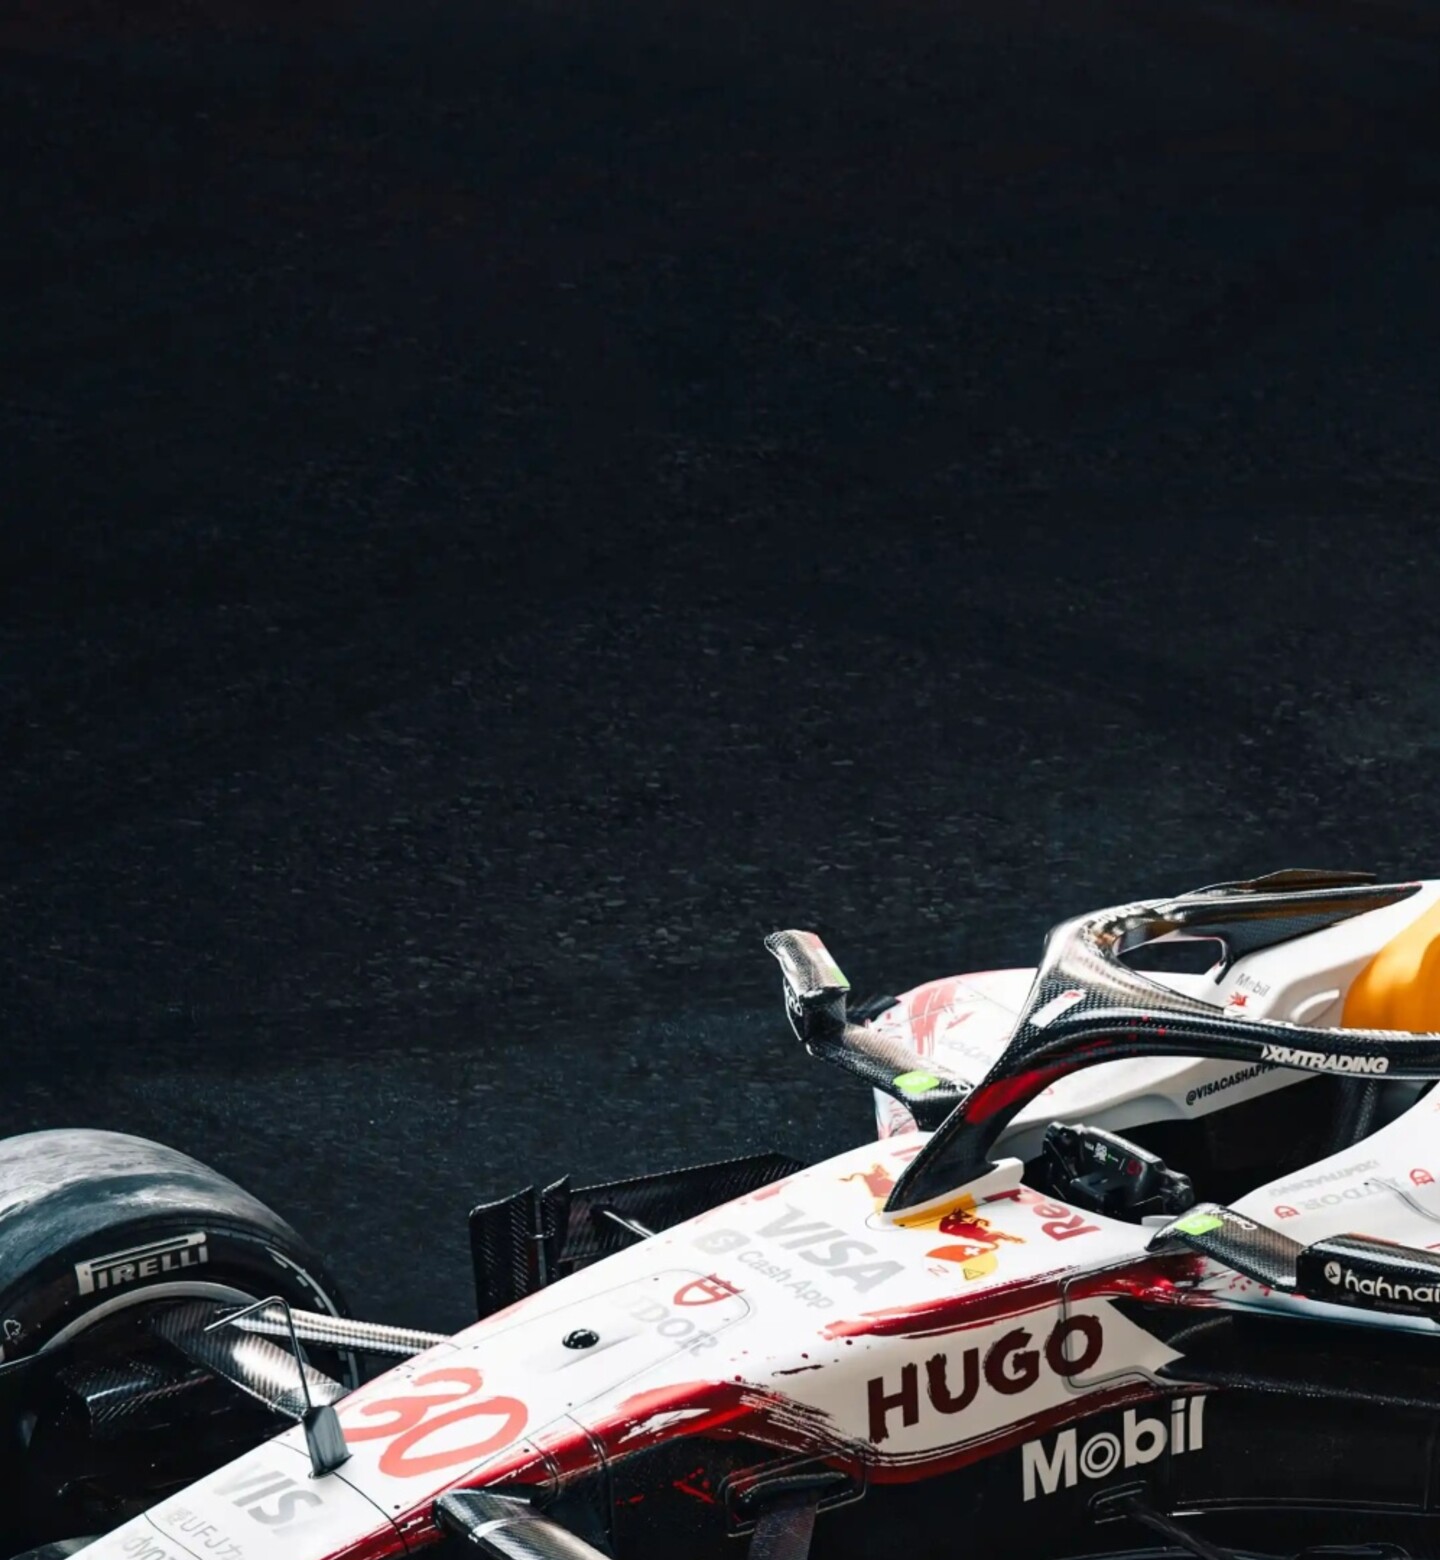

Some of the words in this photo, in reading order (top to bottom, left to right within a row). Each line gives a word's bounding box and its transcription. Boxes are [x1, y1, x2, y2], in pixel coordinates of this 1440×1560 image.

[1264, 1044, 1390, 1074] XMTRADING
[74, 1231, 209, 1296] PIRELLI
[737, 1250, 792, 1284] Cash
[783, 1279, 835, 1310] App
[754, 1202, 907, 1294] VISA
[628, 1299, 719, 1357] DOR
[867, 1313, 1104, 1443] HUGO
[338, 1366, 529, 1479] 30
[1022, 1394, 1207, 1502] Mobil
[213, 1463, 324, 1530] VIS
